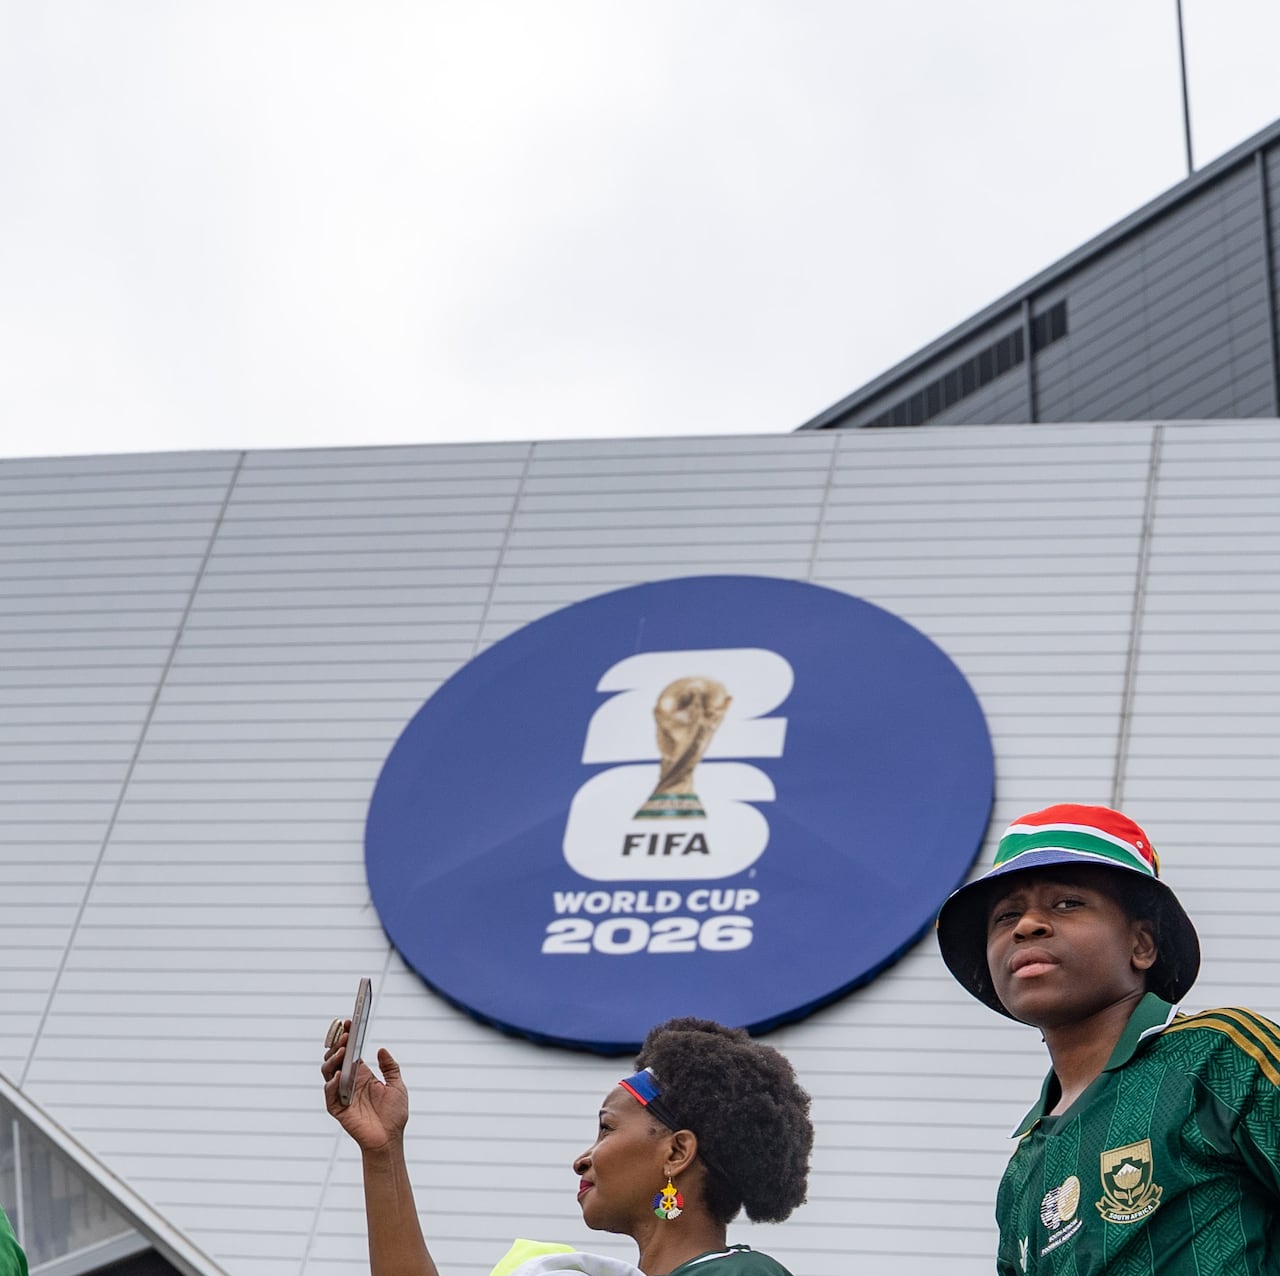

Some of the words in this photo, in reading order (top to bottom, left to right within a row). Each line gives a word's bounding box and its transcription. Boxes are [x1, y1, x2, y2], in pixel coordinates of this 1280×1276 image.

[621, 833, 711, 857] FIFA
[553, 890, 682, 915] WORLD
[686, 888, 760, 912] CUP
[541, 914, 754, 955] 2026
[1109, 1212, 1130, 1221] SOUTH
[1130, 1204, 1154, 1220] AFRICA
